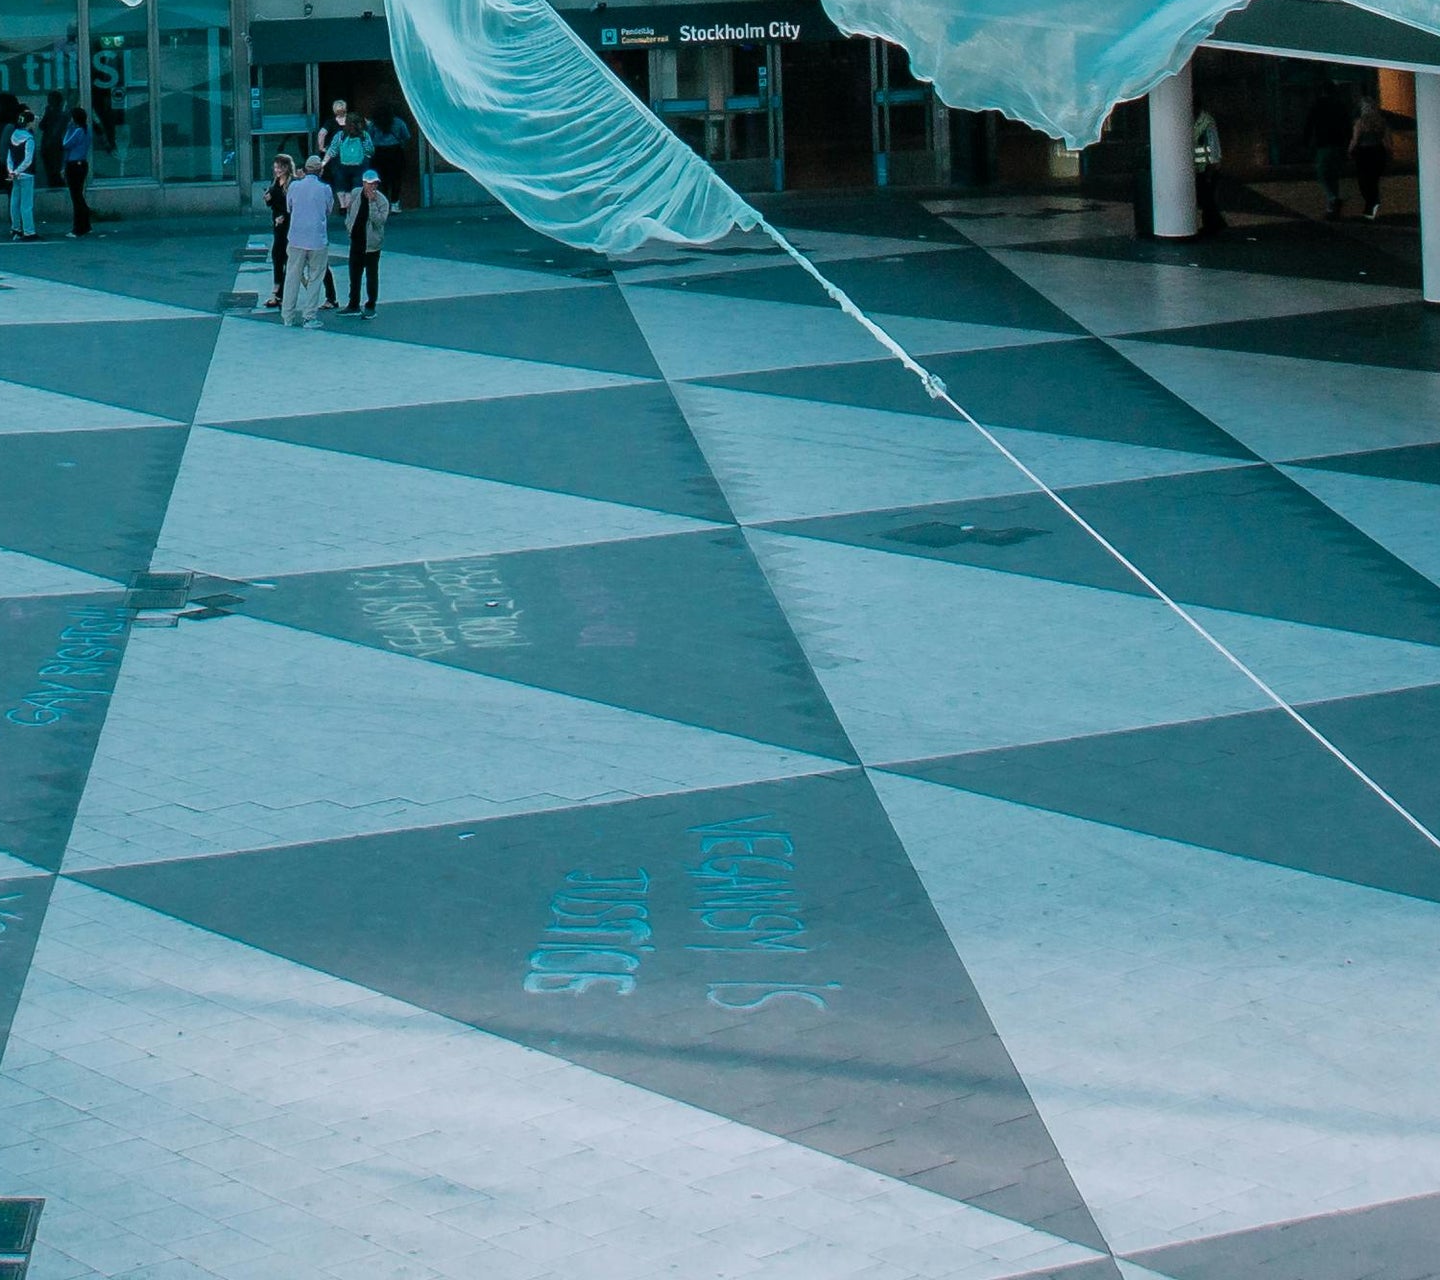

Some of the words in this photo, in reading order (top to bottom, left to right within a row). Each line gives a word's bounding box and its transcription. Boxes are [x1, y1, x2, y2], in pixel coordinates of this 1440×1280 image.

[678, 24, 765, 43] Stockholm
[768, 21, 801, 42] City
[22, 48, 78, 92] till
[92, 49, 149, 90] SL
[688, 812, 810, 955] VEGANISM
[706, 980, 841, 1013] IS
